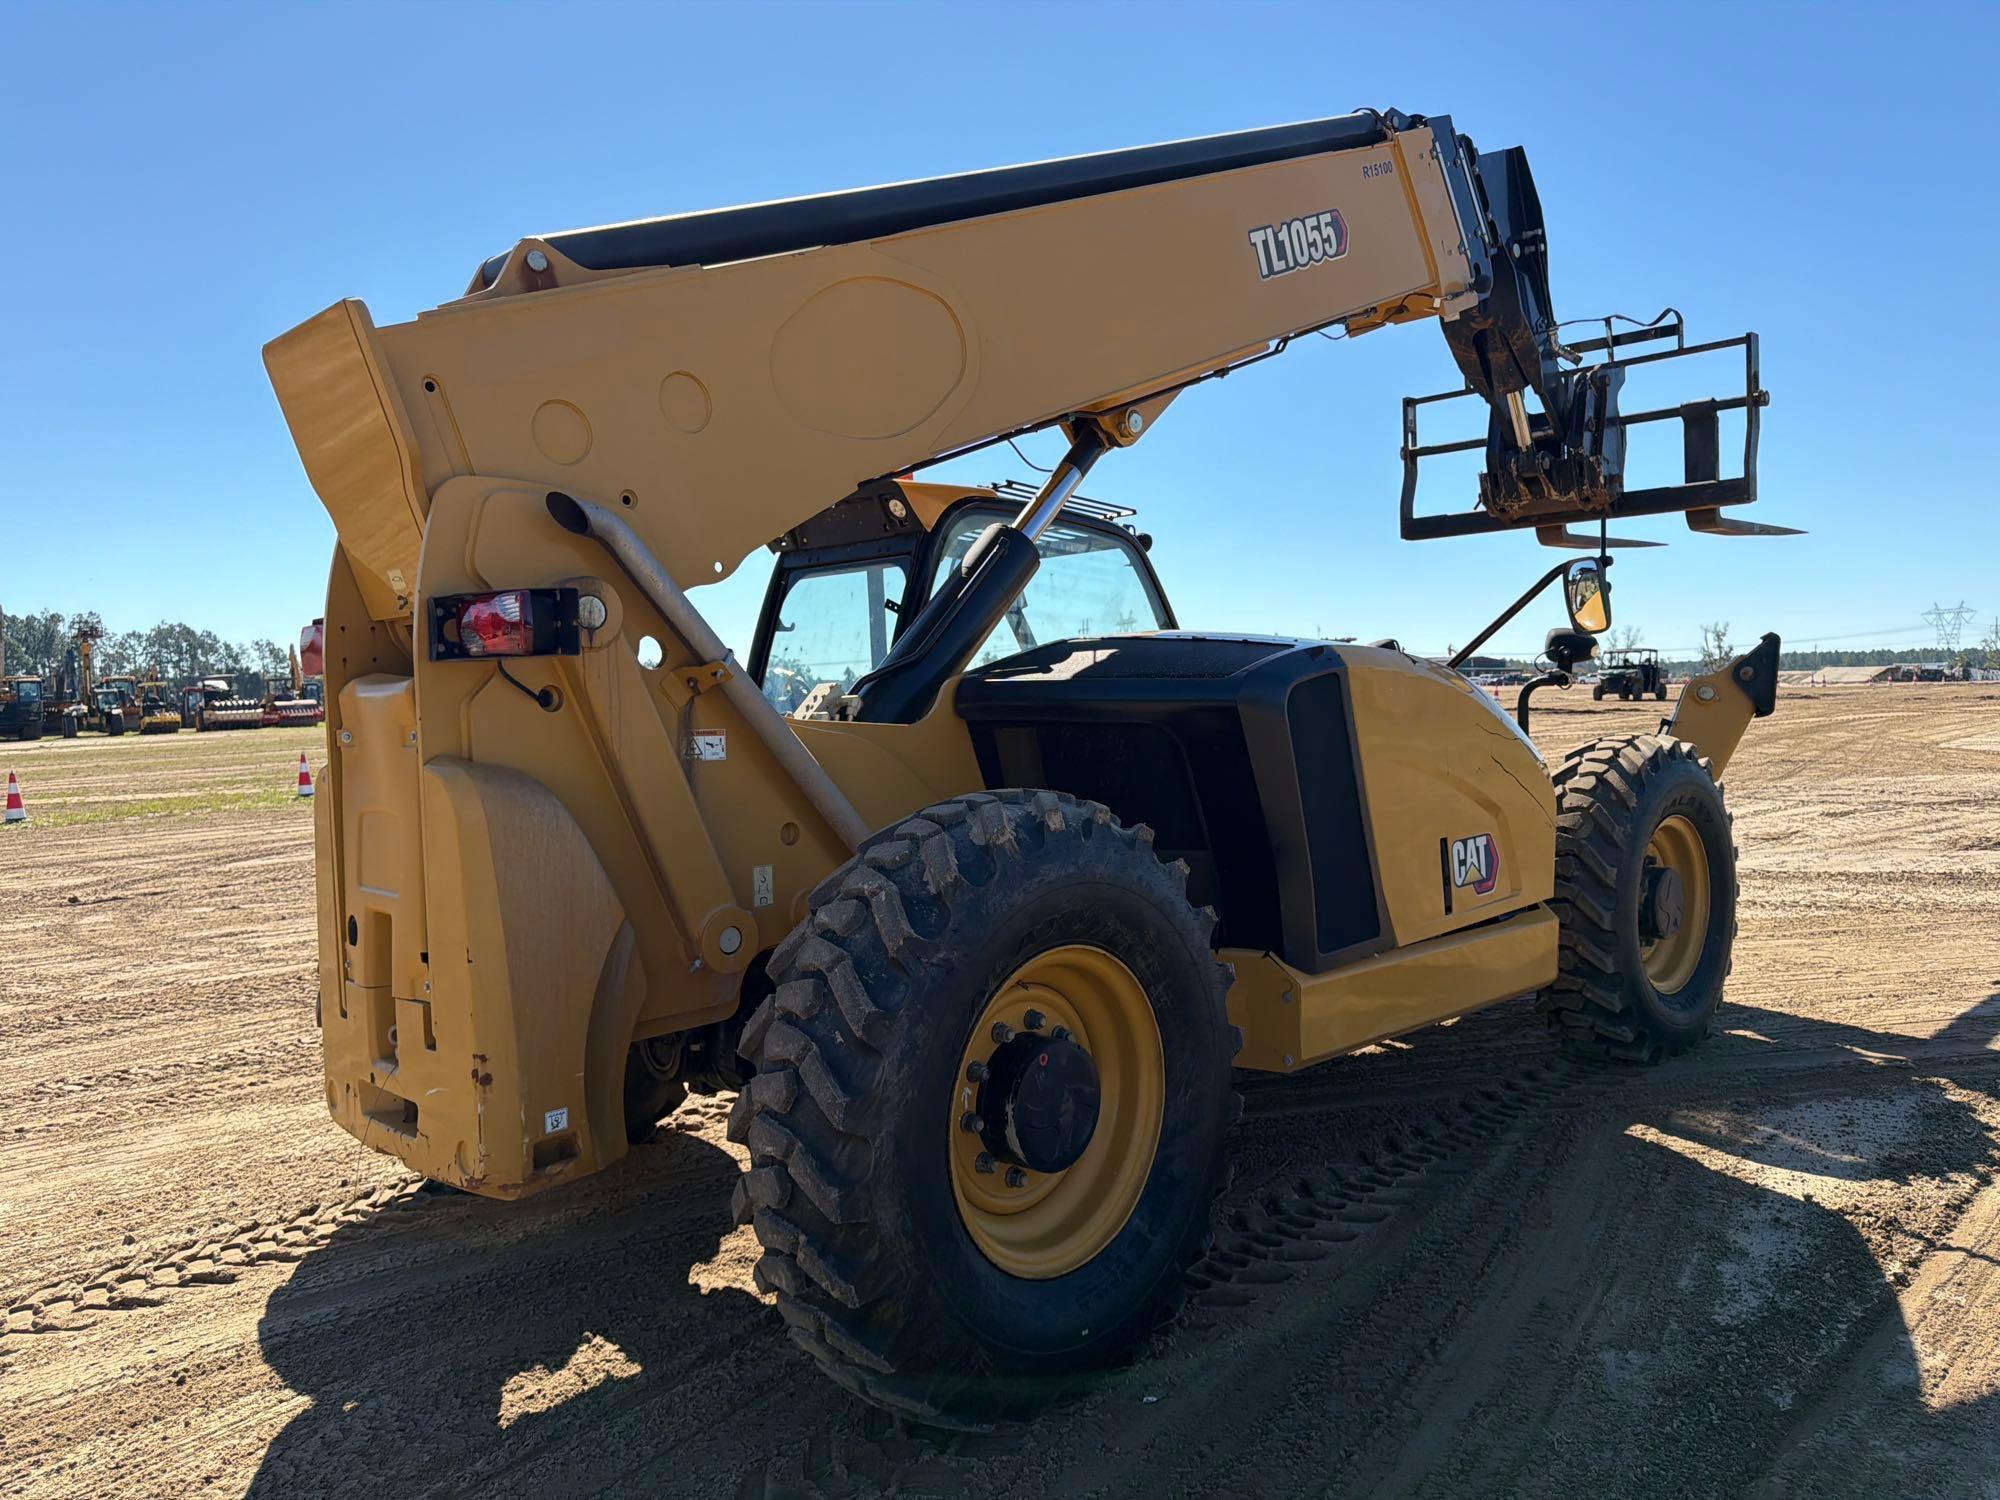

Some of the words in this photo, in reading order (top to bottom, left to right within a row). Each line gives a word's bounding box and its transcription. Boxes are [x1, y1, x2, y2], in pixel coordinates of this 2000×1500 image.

[1362, 160, 1393, 179] R15100
[1250, 211, 1338, 276] TL1055
[1452, 835, 1487, 887] CAT
